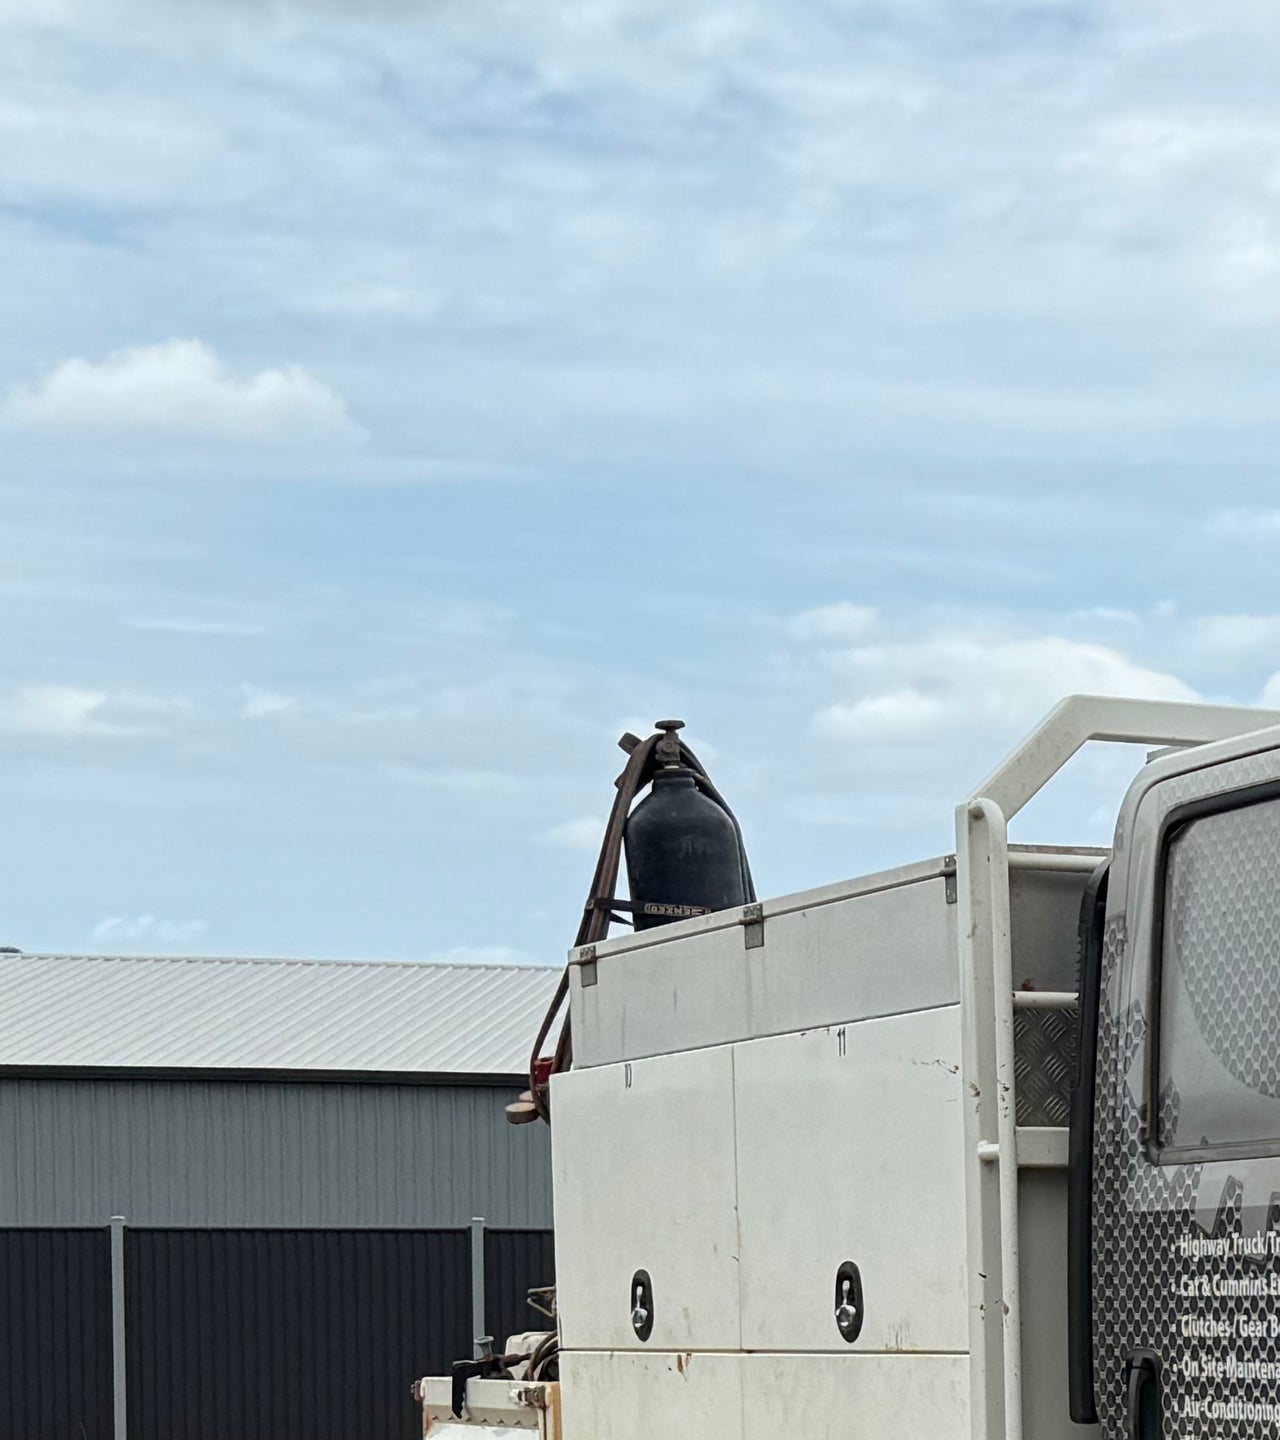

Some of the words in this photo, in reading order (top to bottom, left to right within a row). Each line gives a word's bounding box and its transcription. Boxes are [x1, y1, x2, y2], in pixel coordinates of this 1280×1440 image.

[1180, 1232, 1230, 1262] Highway
[1201, 1274, 1212, 1297] &
[1212, 1272, 1268, 1297] Cummins
[1181, 1313, 1230, 1338] Clutches
[1239, 1314, 1268, 1338] Gear
[1182, 1355, 1200, 1378] On
